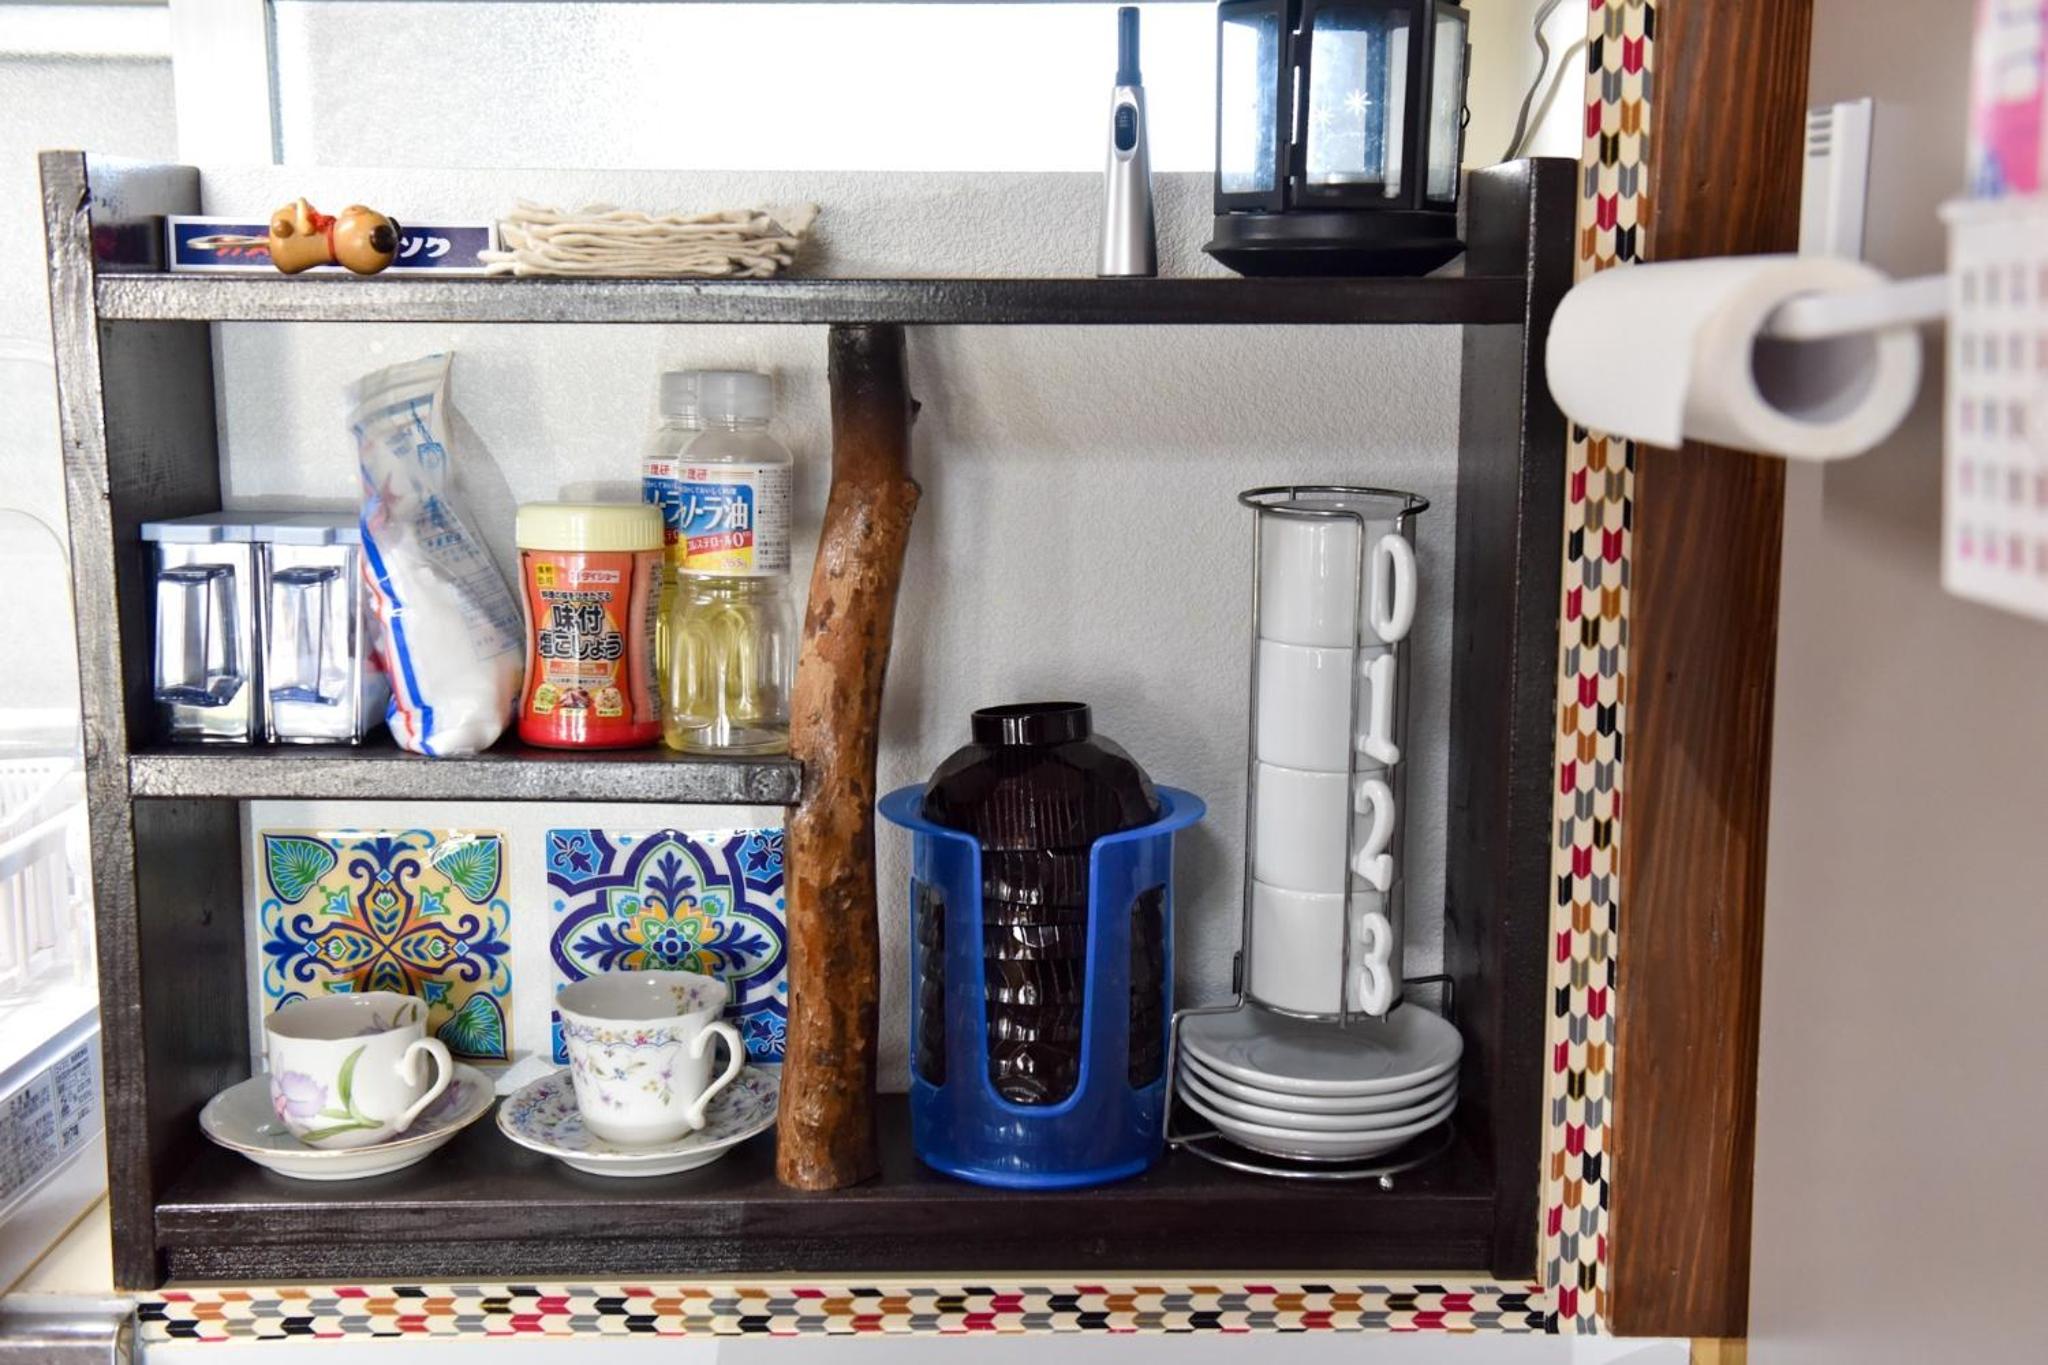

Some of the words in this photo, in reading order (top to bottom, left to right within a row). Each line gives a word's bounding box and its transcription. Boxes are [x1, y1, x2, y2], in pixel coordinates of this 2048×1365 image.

[552, 604, 605, 635] 味付
[539, 631, 625, 661] 塩こしょう
